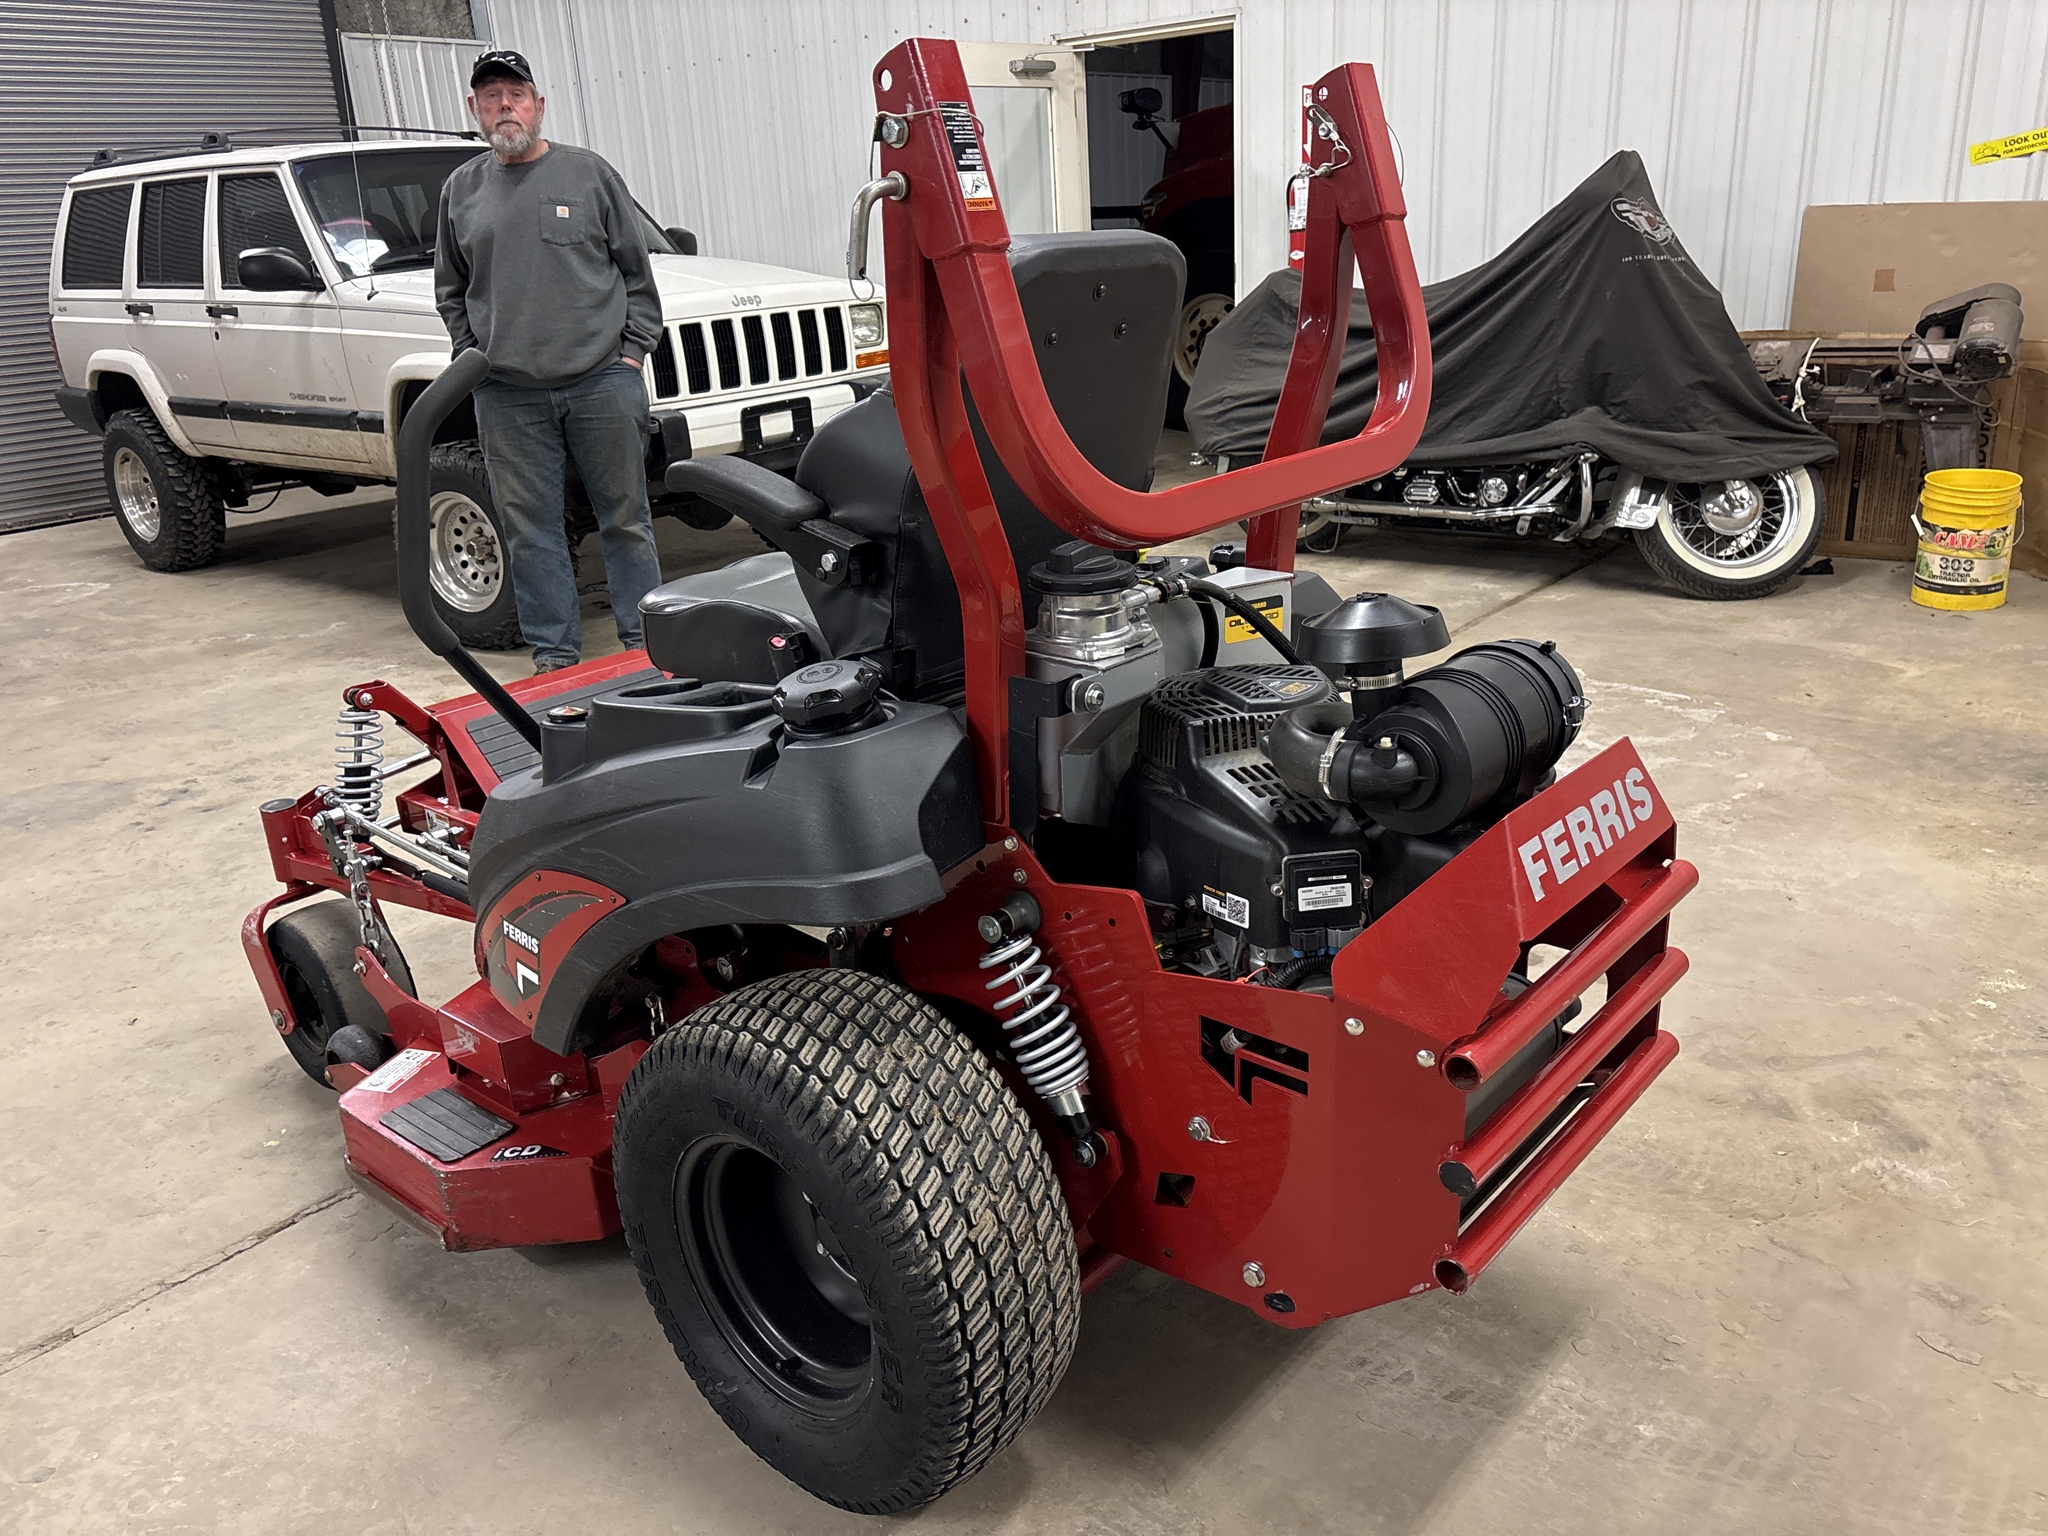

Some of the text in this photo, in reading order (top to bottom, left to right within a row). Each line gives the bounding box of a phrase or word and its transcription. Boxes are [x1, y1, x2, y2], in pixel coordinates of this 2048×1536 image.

[2004, 135, 2029, 148] LOOK
[966, 200, 990, 208] WARNING
[731, 294, 762, 308] Jeep
[1852, 429, 1866, 481] ADVERTENCIA
[1934, 531, 1989, 550] CAM2
[1939, 556, 1975, 572] 303
[1517, 767, 1654, 903] FERRIS
[503, 920, 539, 954] FERRIS
[493, 1144, 542, 1159] iCD
